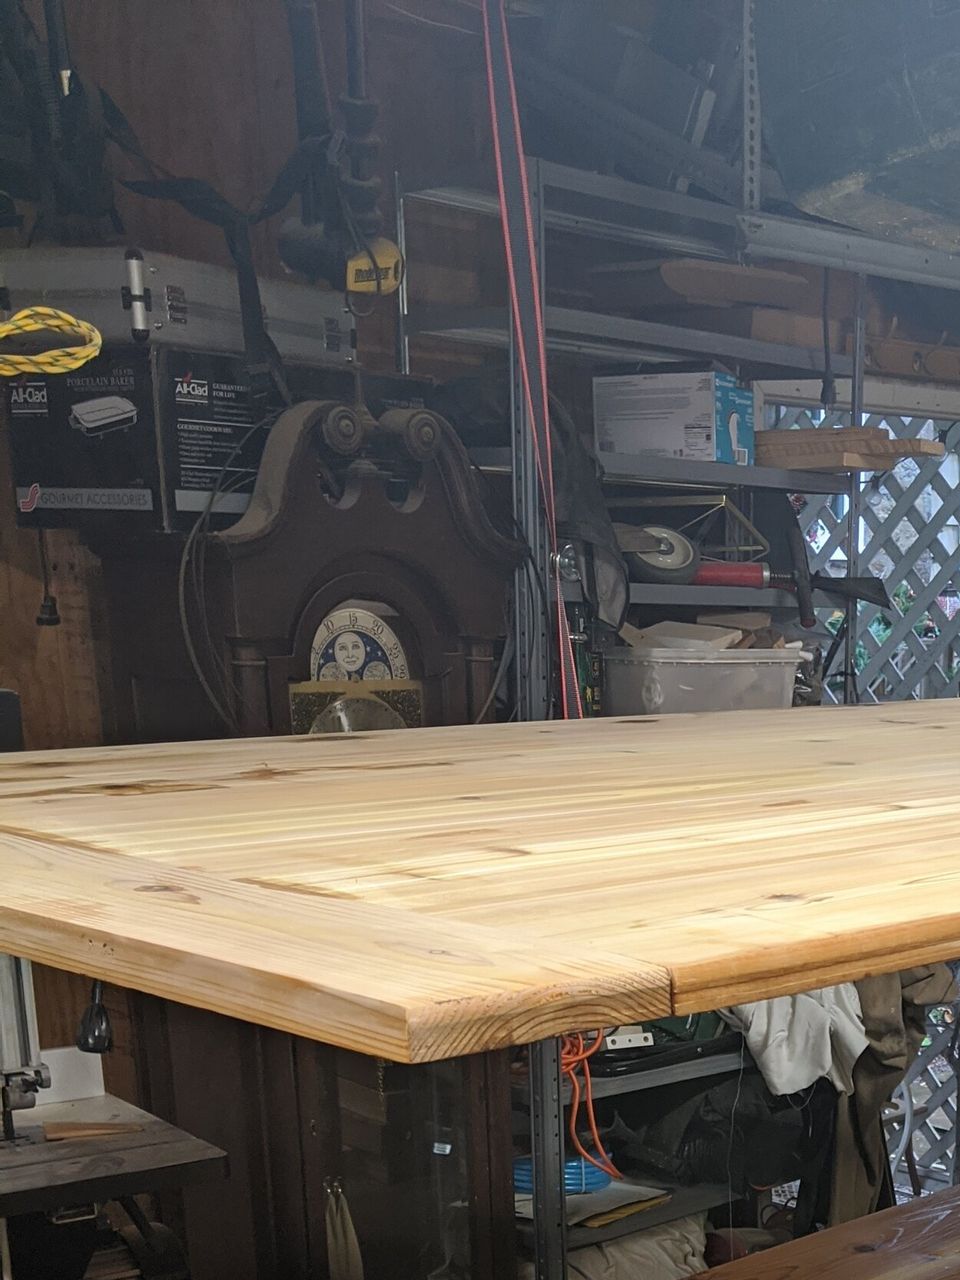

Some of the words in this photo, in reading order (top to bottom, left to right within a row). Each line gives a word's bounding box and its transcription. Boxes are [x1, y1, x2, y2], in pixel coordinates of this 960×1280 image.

[11, 388, 47, 402] All-Clad
[176, 383, 208, 396] All-Clad
[87, 494, 148, 506] ACCESSORIES
